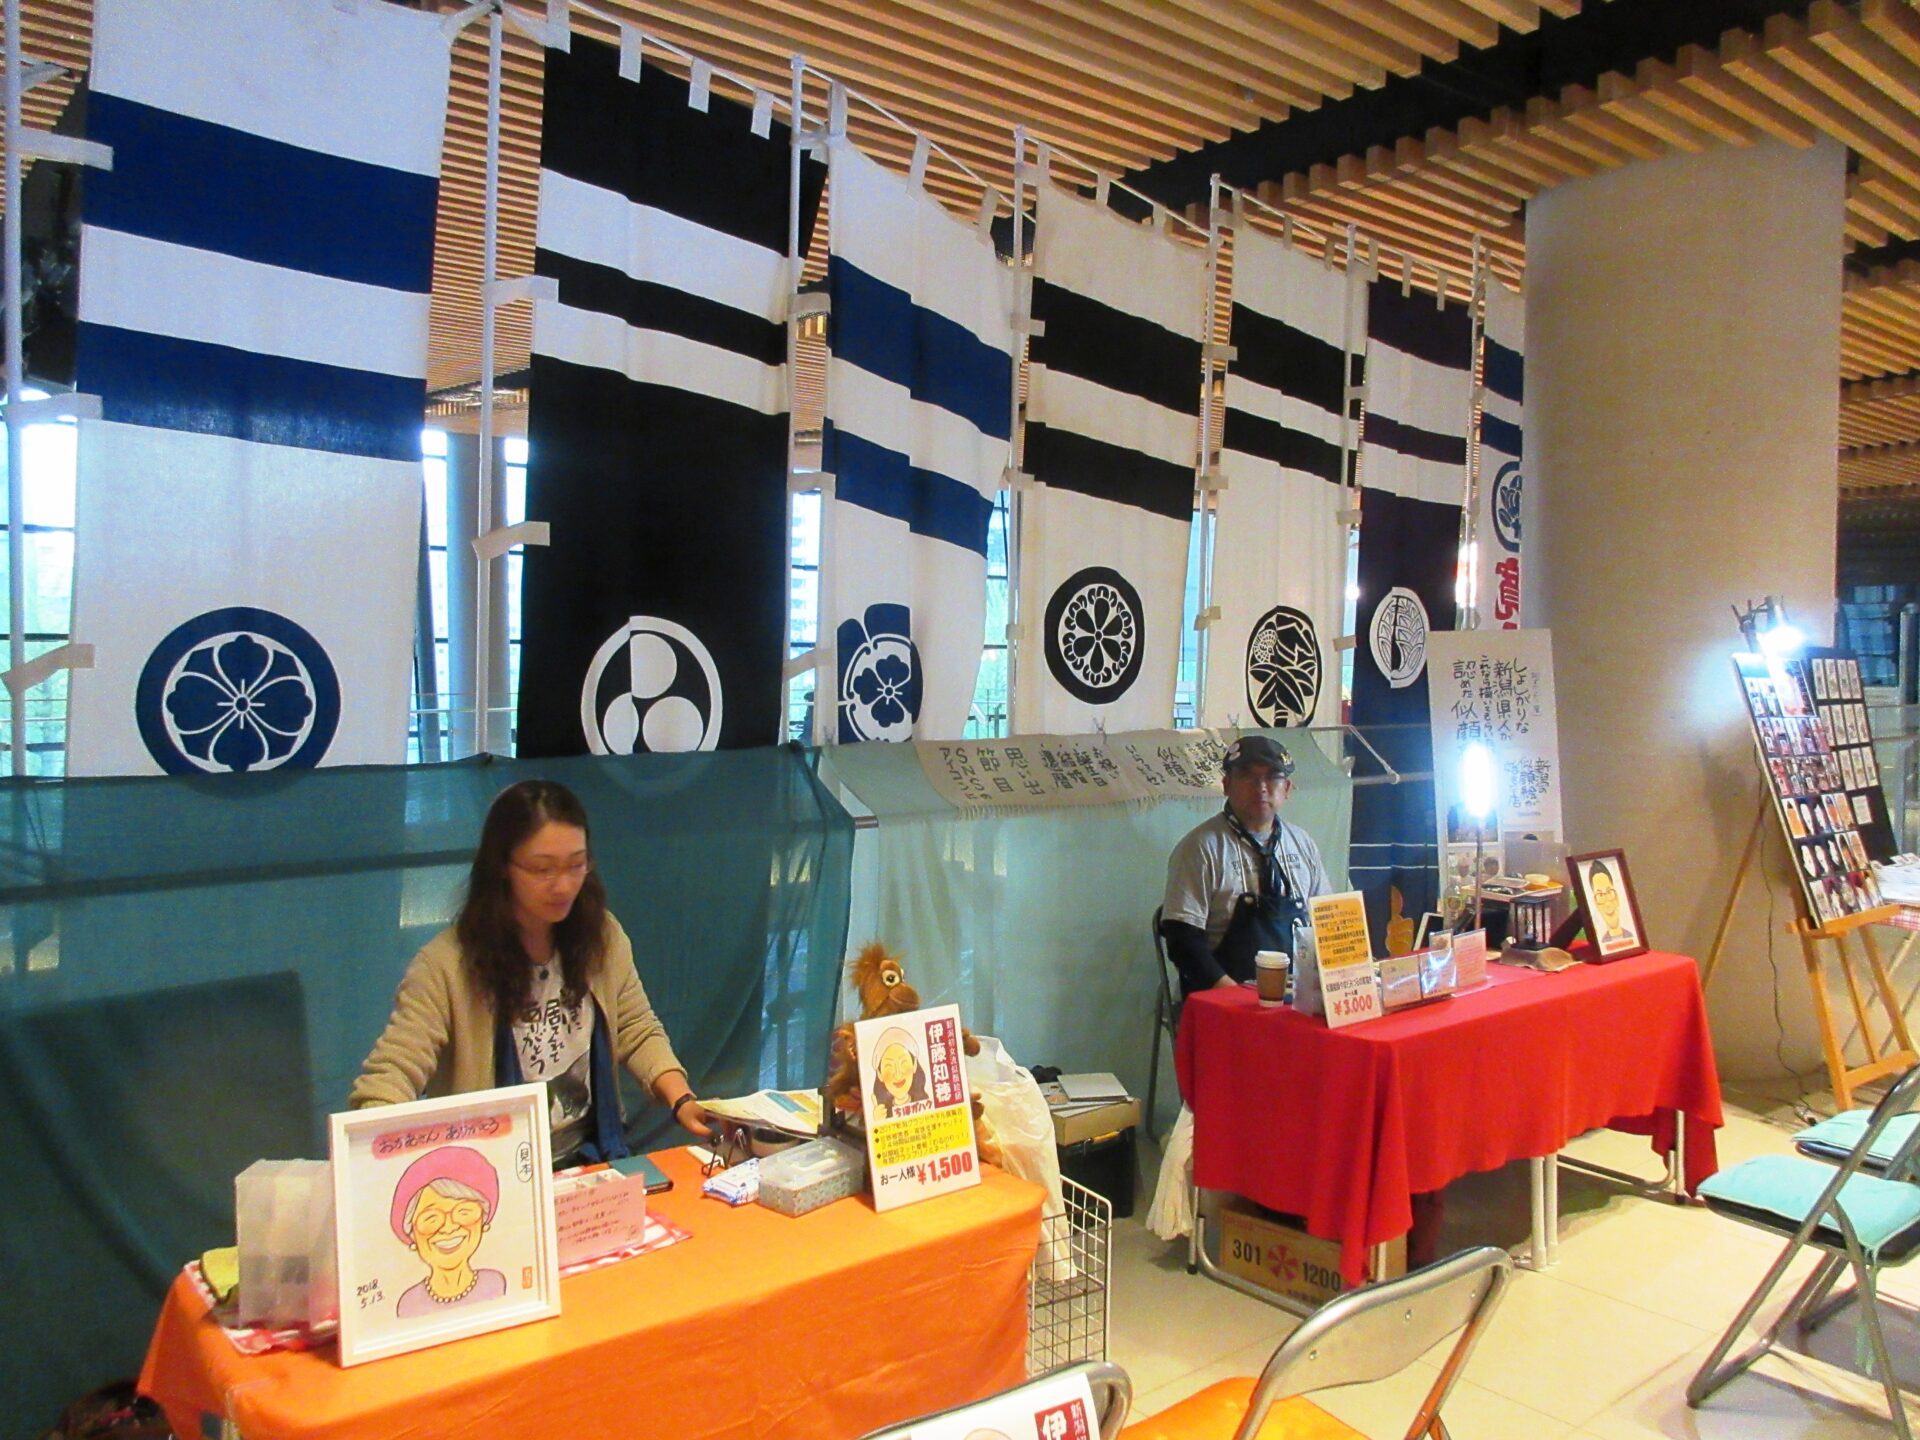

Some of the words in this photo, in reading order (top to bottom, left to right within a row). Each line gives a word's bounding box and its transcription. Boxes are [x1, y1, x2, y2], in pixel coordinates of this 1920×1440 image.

[1493, 660, 1513, 741] 新潟県人が
[1513, 657, 1530, 734] しょしがりな
[955, 747, 992, 800] SNSの
[976, 747, 1014, 793] 節目
[1004, 747, 1045, 796] 思い出
[929, 1023, 952, 1103] 伊藤知穂
[379, 1131, 440, 1154] おかあさん
[445, 1117, 500, 1140] ありがとう
[519, 1149, 532, 1176] 見本
[880, 1166, 916, 1186] お一人様
[917, 1151, 973, 1185] ¥1,500
[357, 1278, 379, 1297] 2018
[1233, 1239, 1261, 1266] 301
[1303, 1261, 1341, 1292] 1200
